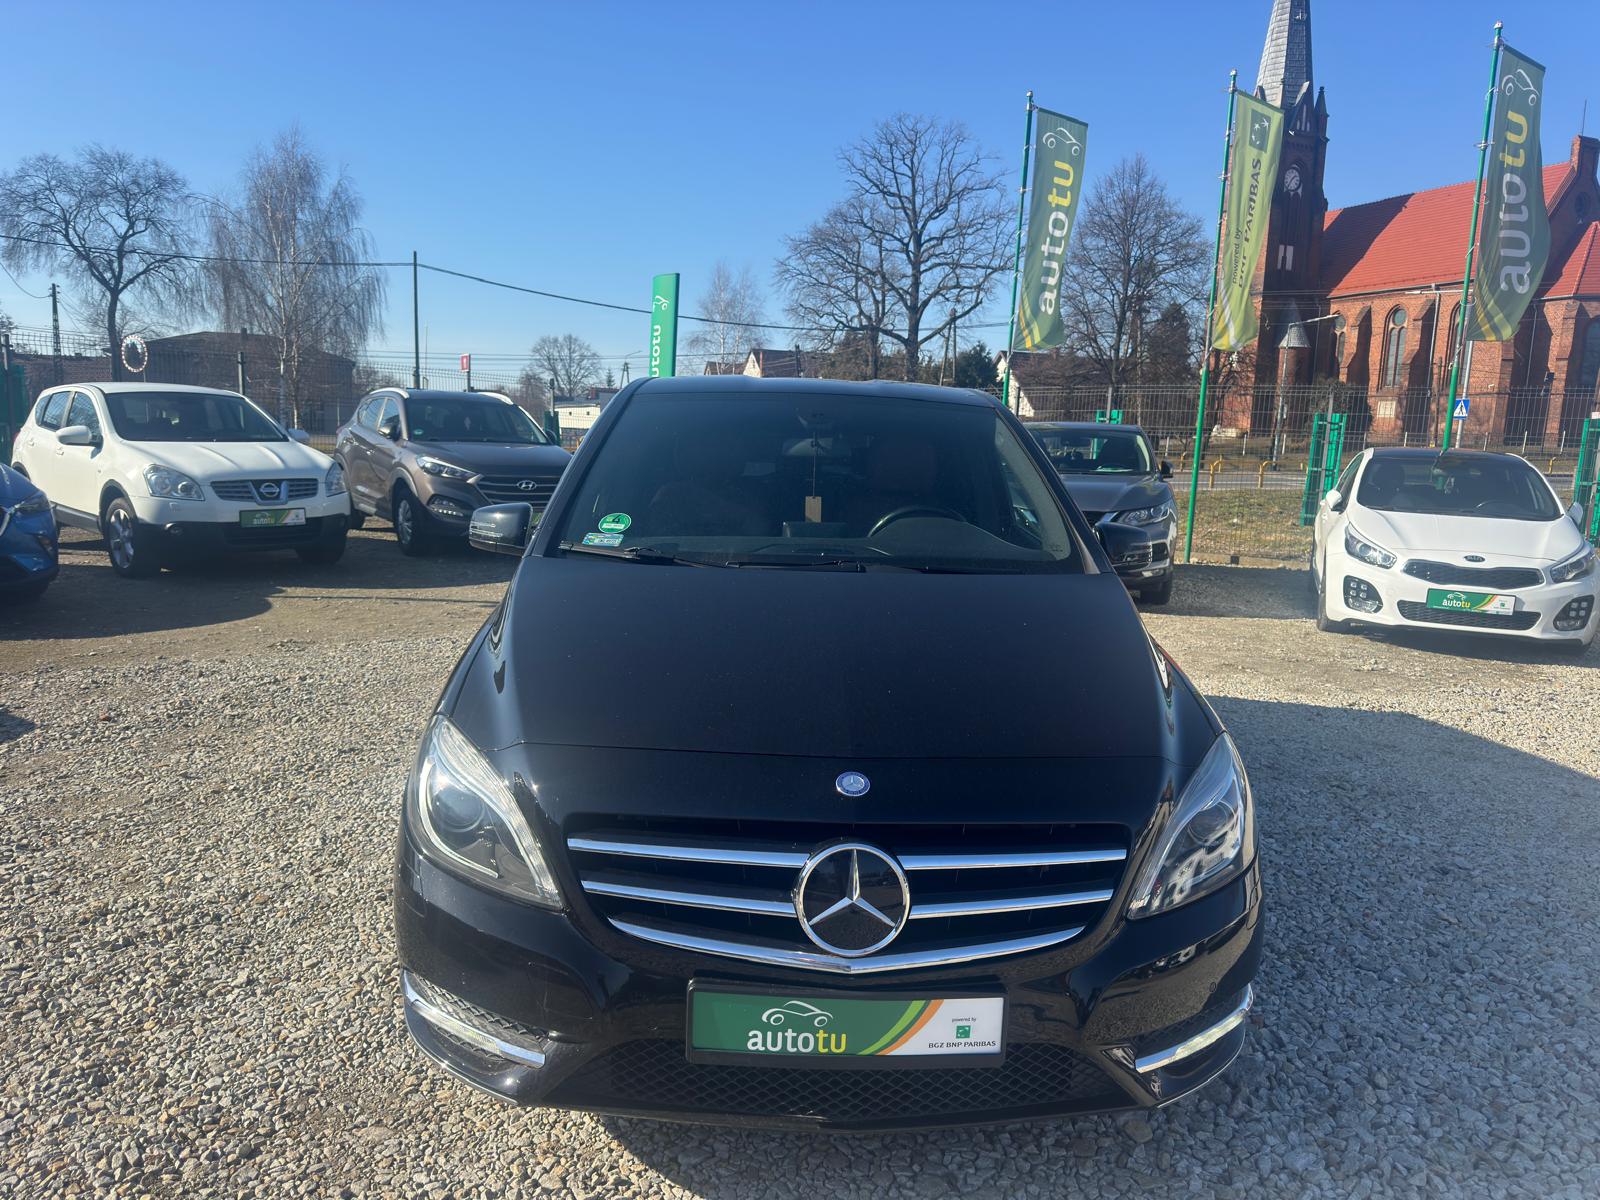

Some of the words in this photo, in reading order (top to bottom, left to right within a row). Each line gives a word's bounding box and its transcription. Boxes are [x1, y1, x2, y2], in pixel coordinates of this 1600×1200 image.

[1244, 158, 1261, 243] PARIBAS
[1499, 110, 1531, 294] autotu
[1039, 160, 1074, 315] autotu
[1234, 227, 1242, 240] by
[651, 324, 661, 377] utotu
[1442, 599, 1471, 608] autotu
[747, 1028, 846, 1053] autotu
